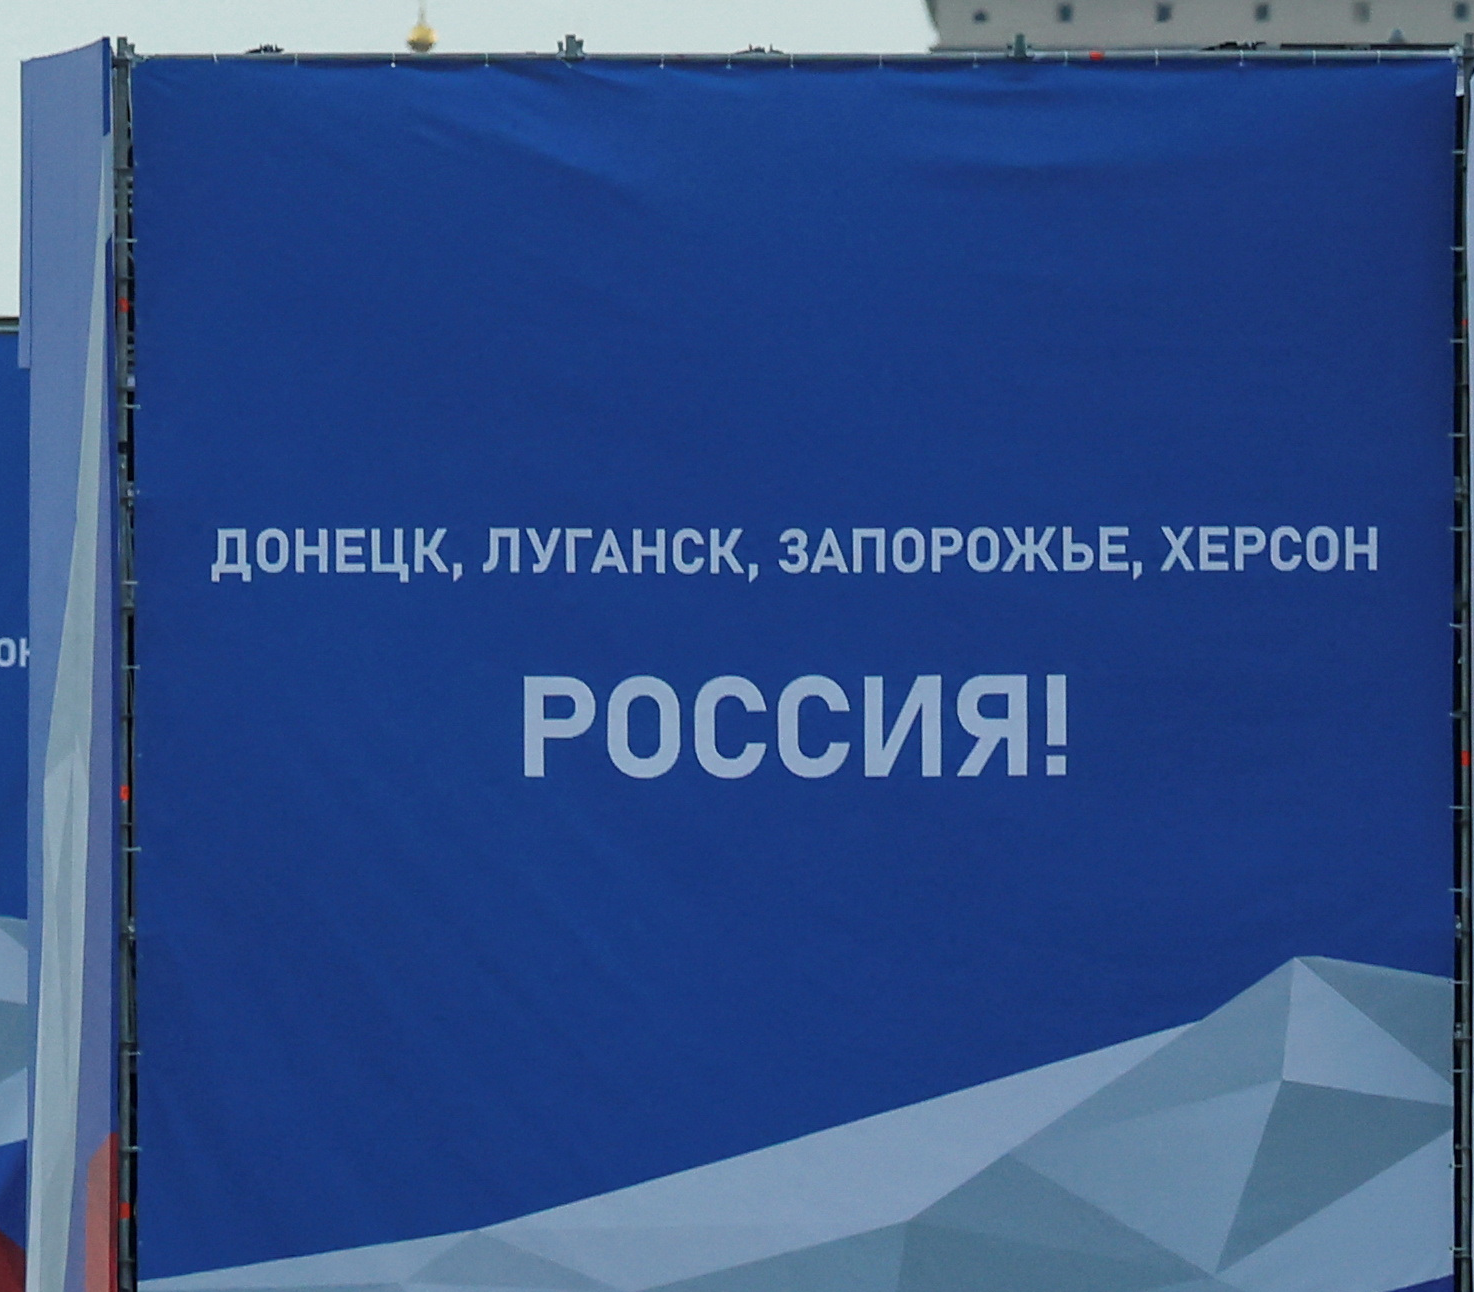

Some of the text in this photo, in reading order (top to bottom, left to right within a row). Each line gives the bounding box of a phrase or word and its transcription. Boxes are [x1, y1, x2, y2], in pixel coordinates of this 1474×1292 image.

[211, 525, 1378, 583] ДОНЕЦК, ЛУГАНСК, ЗАПОРОЖЬЕ, ХЕРСОН
[523, 674, 1067, 779] РОССИЯ!
